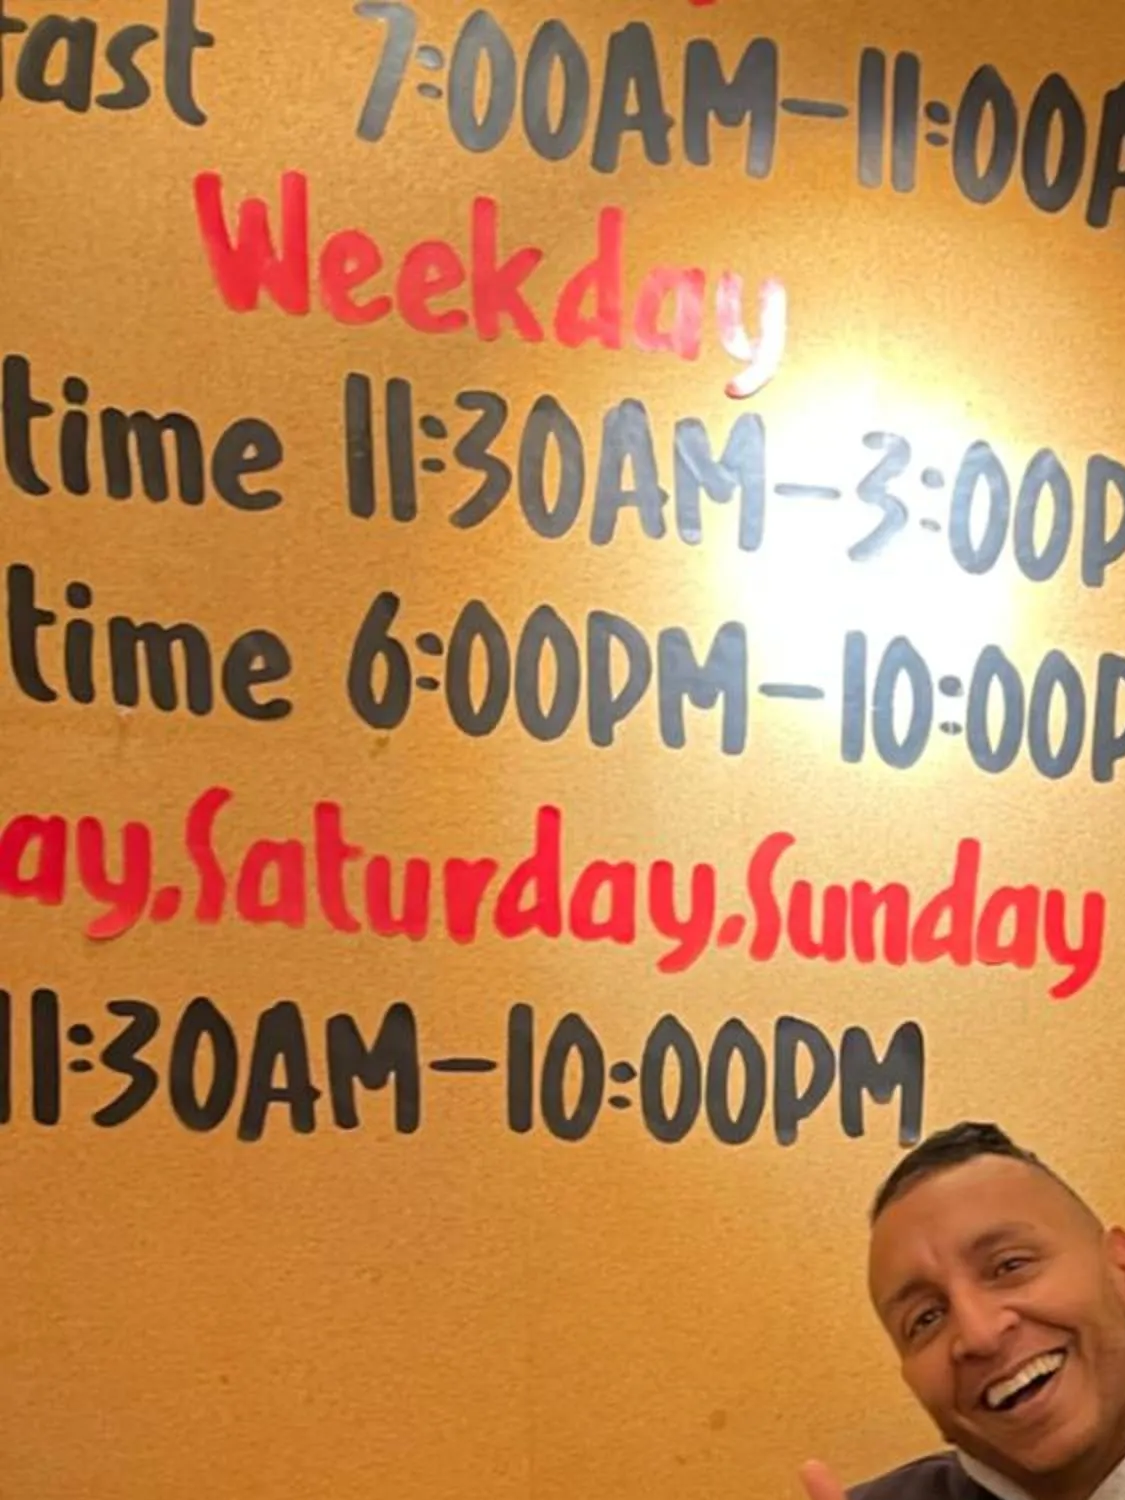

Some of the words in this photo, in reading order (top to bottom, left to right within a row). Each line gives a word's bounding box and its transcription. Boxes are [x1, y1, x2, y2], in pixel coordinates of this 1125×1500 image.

[193, 170, 788, 399] Weekday
[2, 354, 283, 511] time
[7, 563, 293, 721] time
